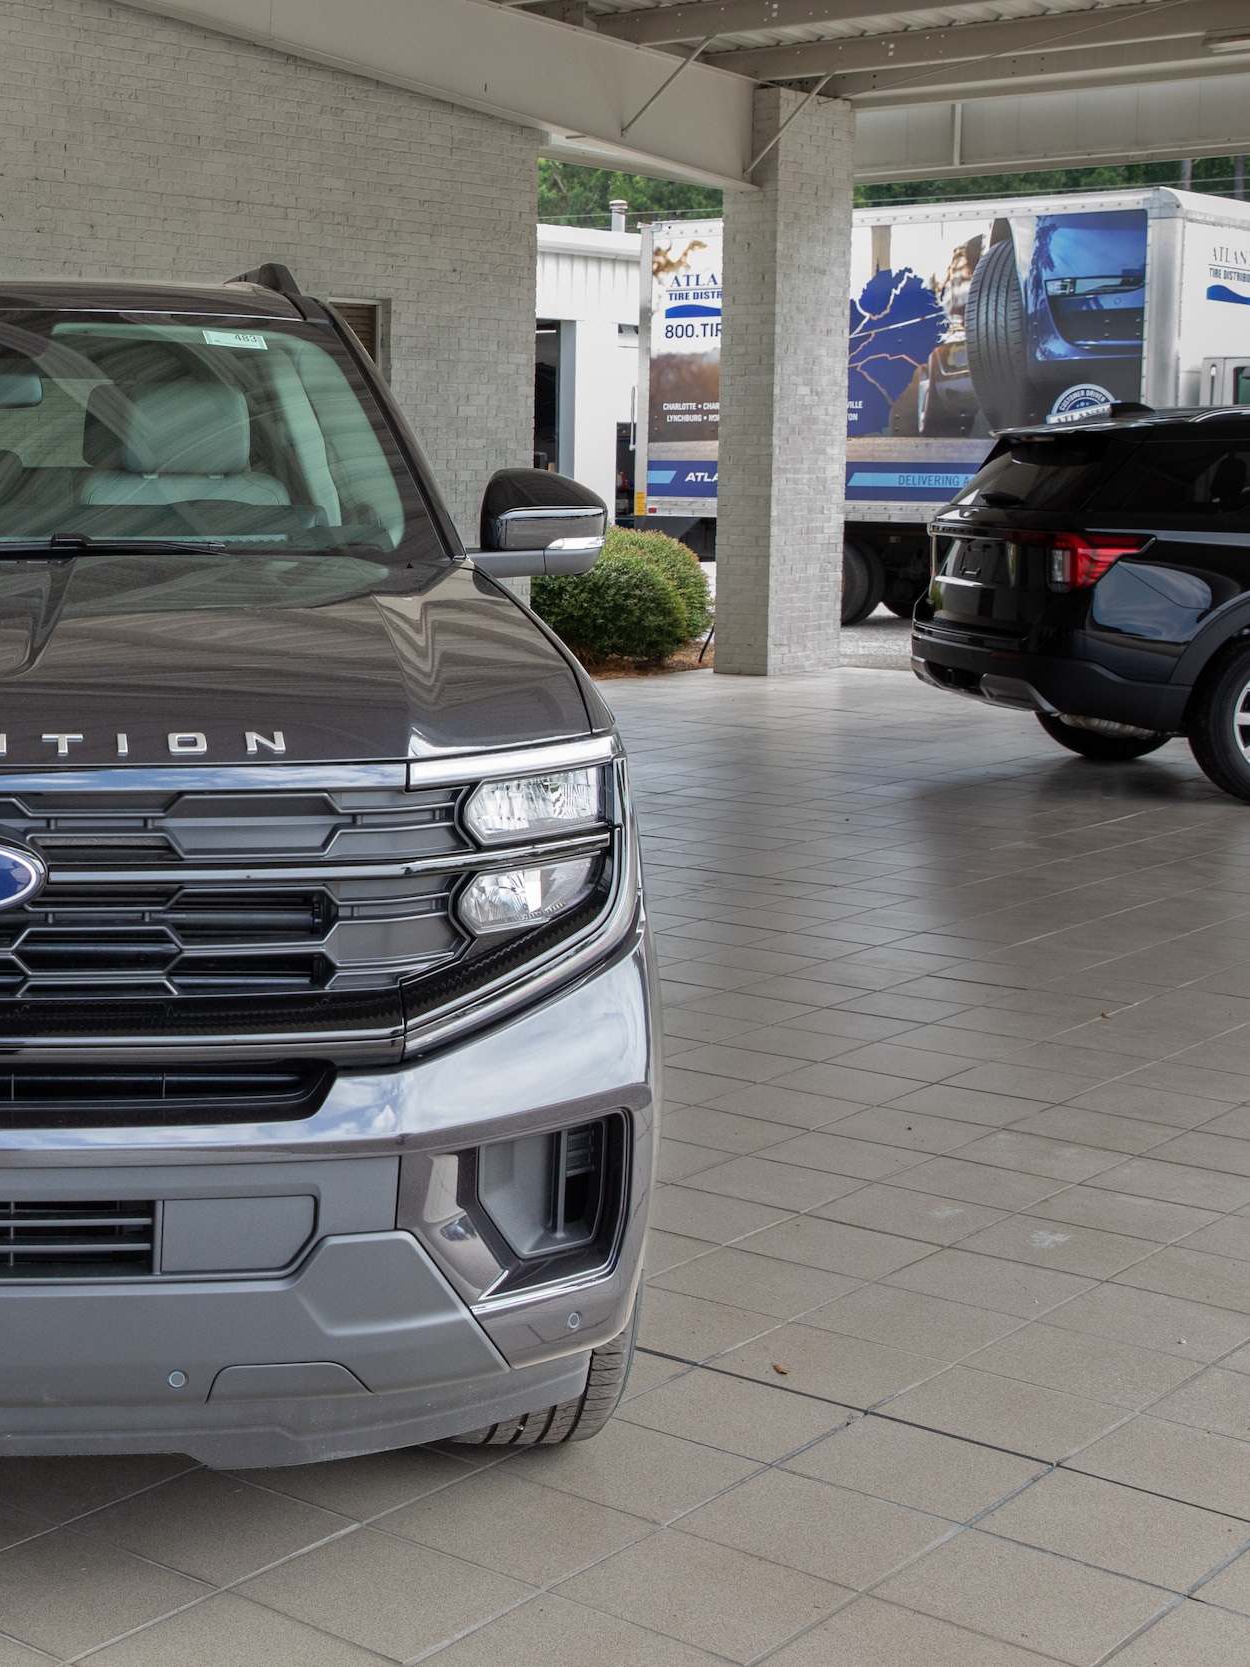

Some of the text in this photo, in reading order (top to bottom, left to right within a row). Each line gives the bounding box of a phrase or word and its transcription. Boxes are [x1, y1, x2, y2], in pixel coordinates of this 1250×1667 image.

[670, 273, 722, 287] ATLA
[668, 290, 723, 301] TIRE DISTR
[234, 334, 258, 343] 483
[1058, 389, 1107, 411] CUSTOMER DRIVEN
[662, 402, 697, 411] CHARLOTTE
[666, 414, 702, 422] LYNCHBURG
[847, 412, 858, 421] ON
[898, 475, 960, 486] DELIVERING
